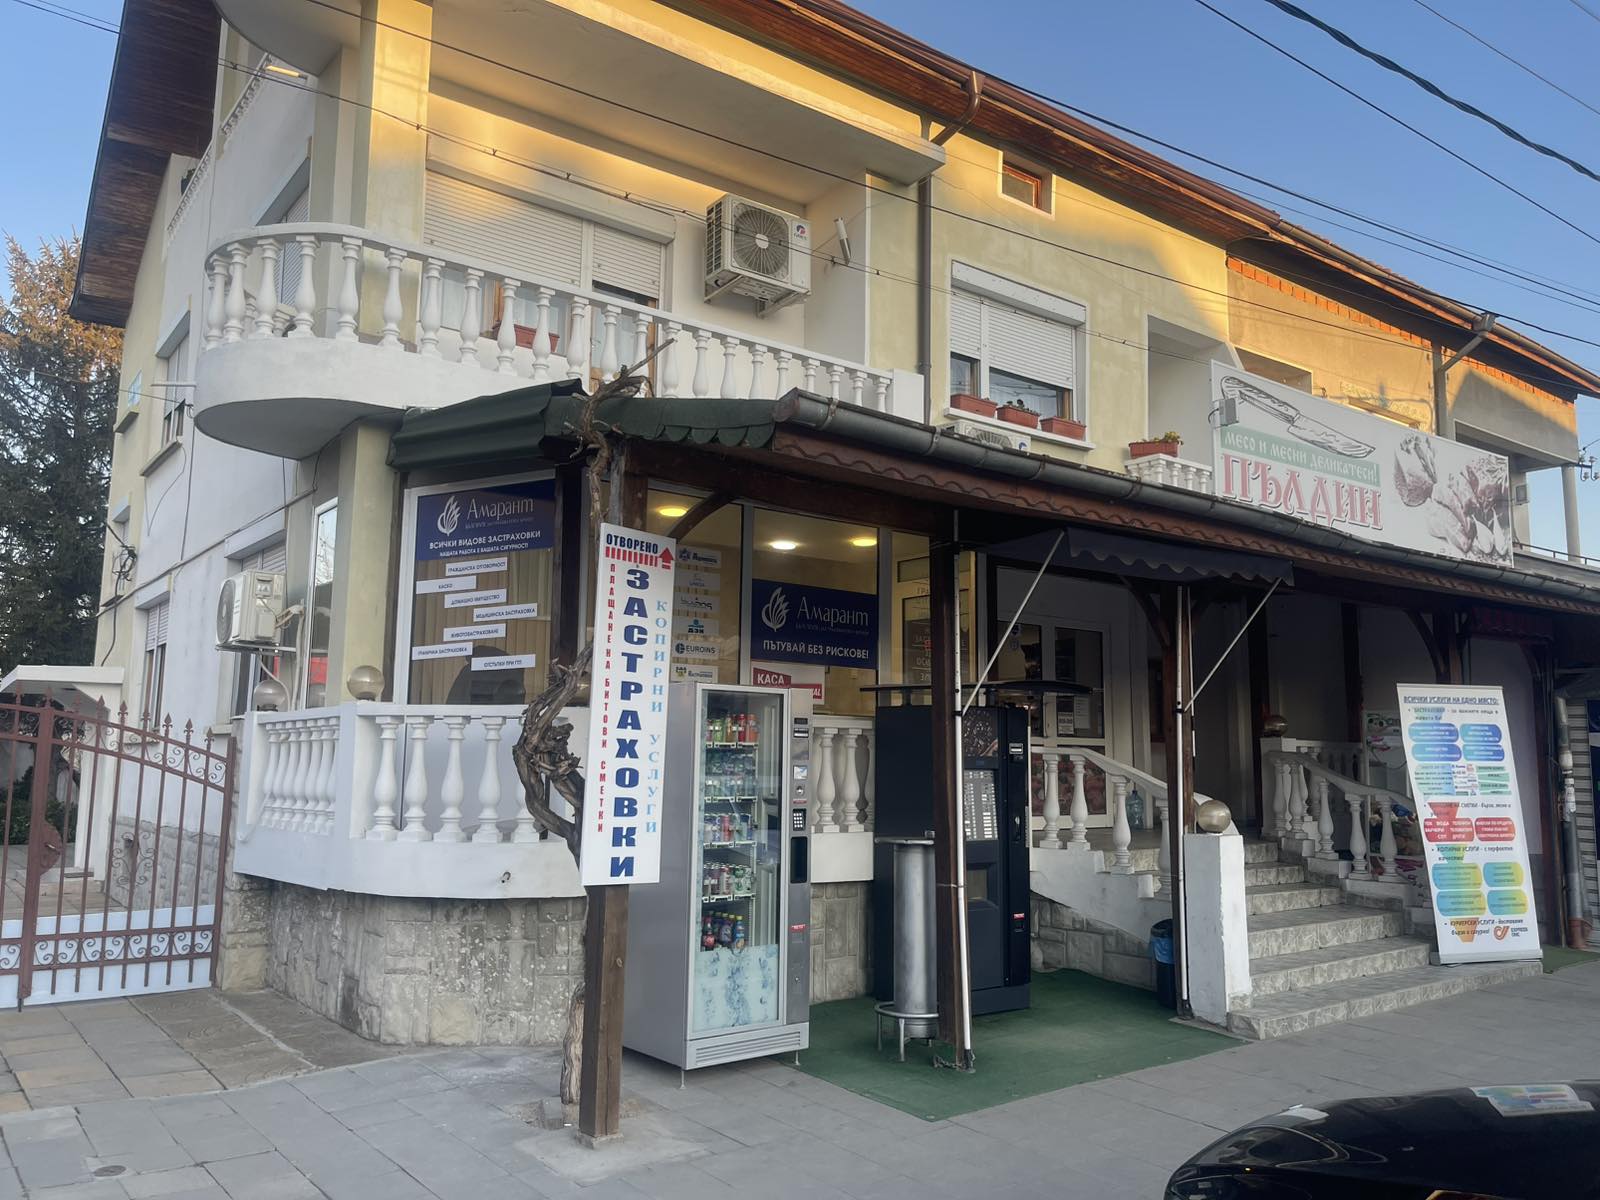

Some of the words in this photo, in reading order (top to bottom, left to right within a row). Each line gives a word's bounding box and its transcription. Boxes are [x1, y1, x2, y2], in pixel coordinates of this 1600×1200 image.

[1224, 431, 1256, 452] МЕСО
[1259, 439, 1267, 454] И
[1270, 443, 1308, 464] МЕСНИ
[1221, 453, 1384, 531] ПЪЛДИН
[466, 498, 534, 520] Амарант
[429, 539, 457, 550] ВСИЧКИ
[458, 535, 487, 547] ВИДОВЕ
[487, 530, 541, 544] ЗАСТРАХОВКИ
[606, 533, 659, 555] ОТВОРЕНО
[607, 563, 615, 644] ПЛАЩАНЕ
[796, 596, 869, 627] Амарант
[605, 649, 611, 670] НА
[651, 600, 668, 713] КОПИРНИ
[686, 645, 716, 654] EUROINS
[763, 639, 806, 652] ПЪТУВАЙ
[808, 644, 824, 655] БЕЗ
[825, 646, 869, 659] РИСКОВЕ!
[757, 673, 785, 685] КАСА
[602, 677, 610, 749] БИТОВИ
[1404, 696, 1428, 704] ВСИЧКИ
[1428, 696, 1451, 704] УСЛУГИ
[609, 568, 650, 878] ЗАСТРАХОВКИ
[597, 760, 606, 833] СМЕТКИ
[645, 734, 661, 833] УСЛУГИ
